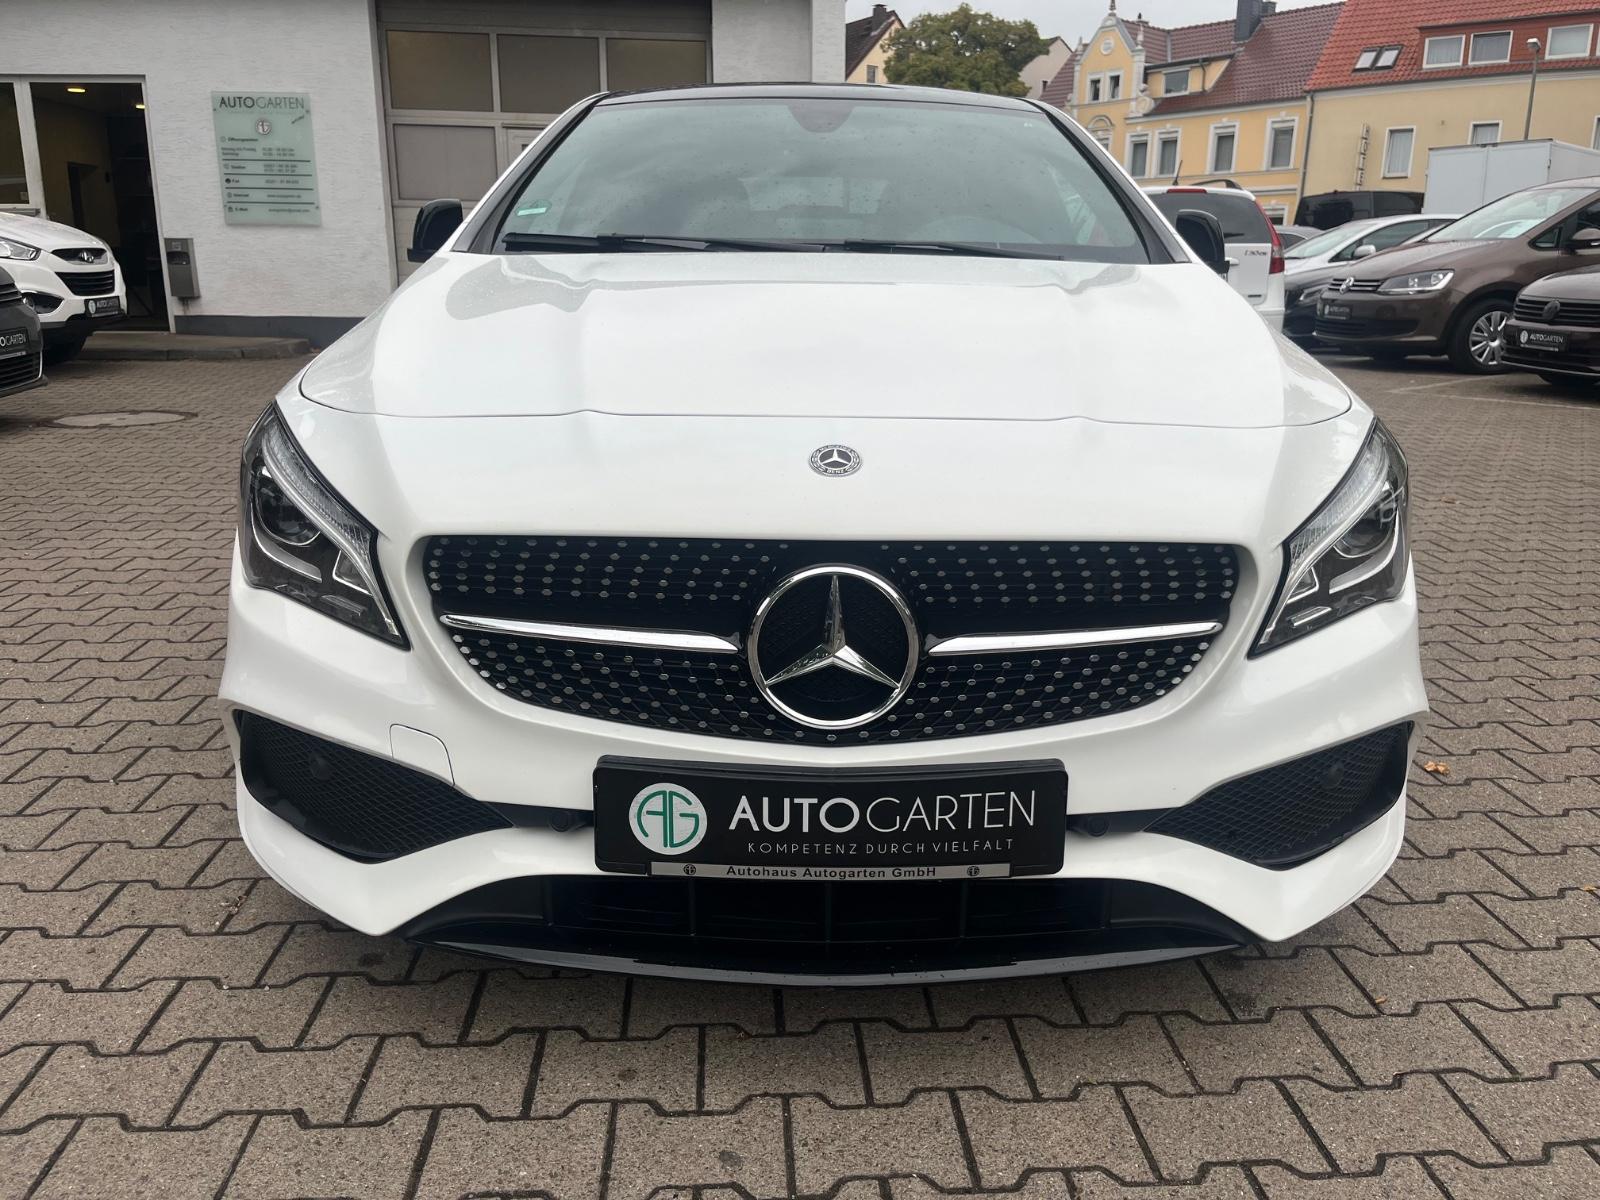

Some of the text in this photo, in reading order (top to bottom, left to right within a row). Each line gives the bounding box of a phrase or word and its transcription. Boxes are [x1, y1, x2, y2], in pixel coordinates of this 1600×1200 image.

[220, 96, 305, 110] AUTOGARTEN
[0, 333, 26, 347] OGARTEN
[728, 790, 1036, 833] AUTOGARTEN
[747, 838, 1014, 855] KOMPETENZ DURCH VIELFALT
[726, 865, 936, 880] Autohaus Autogarten GmbH
